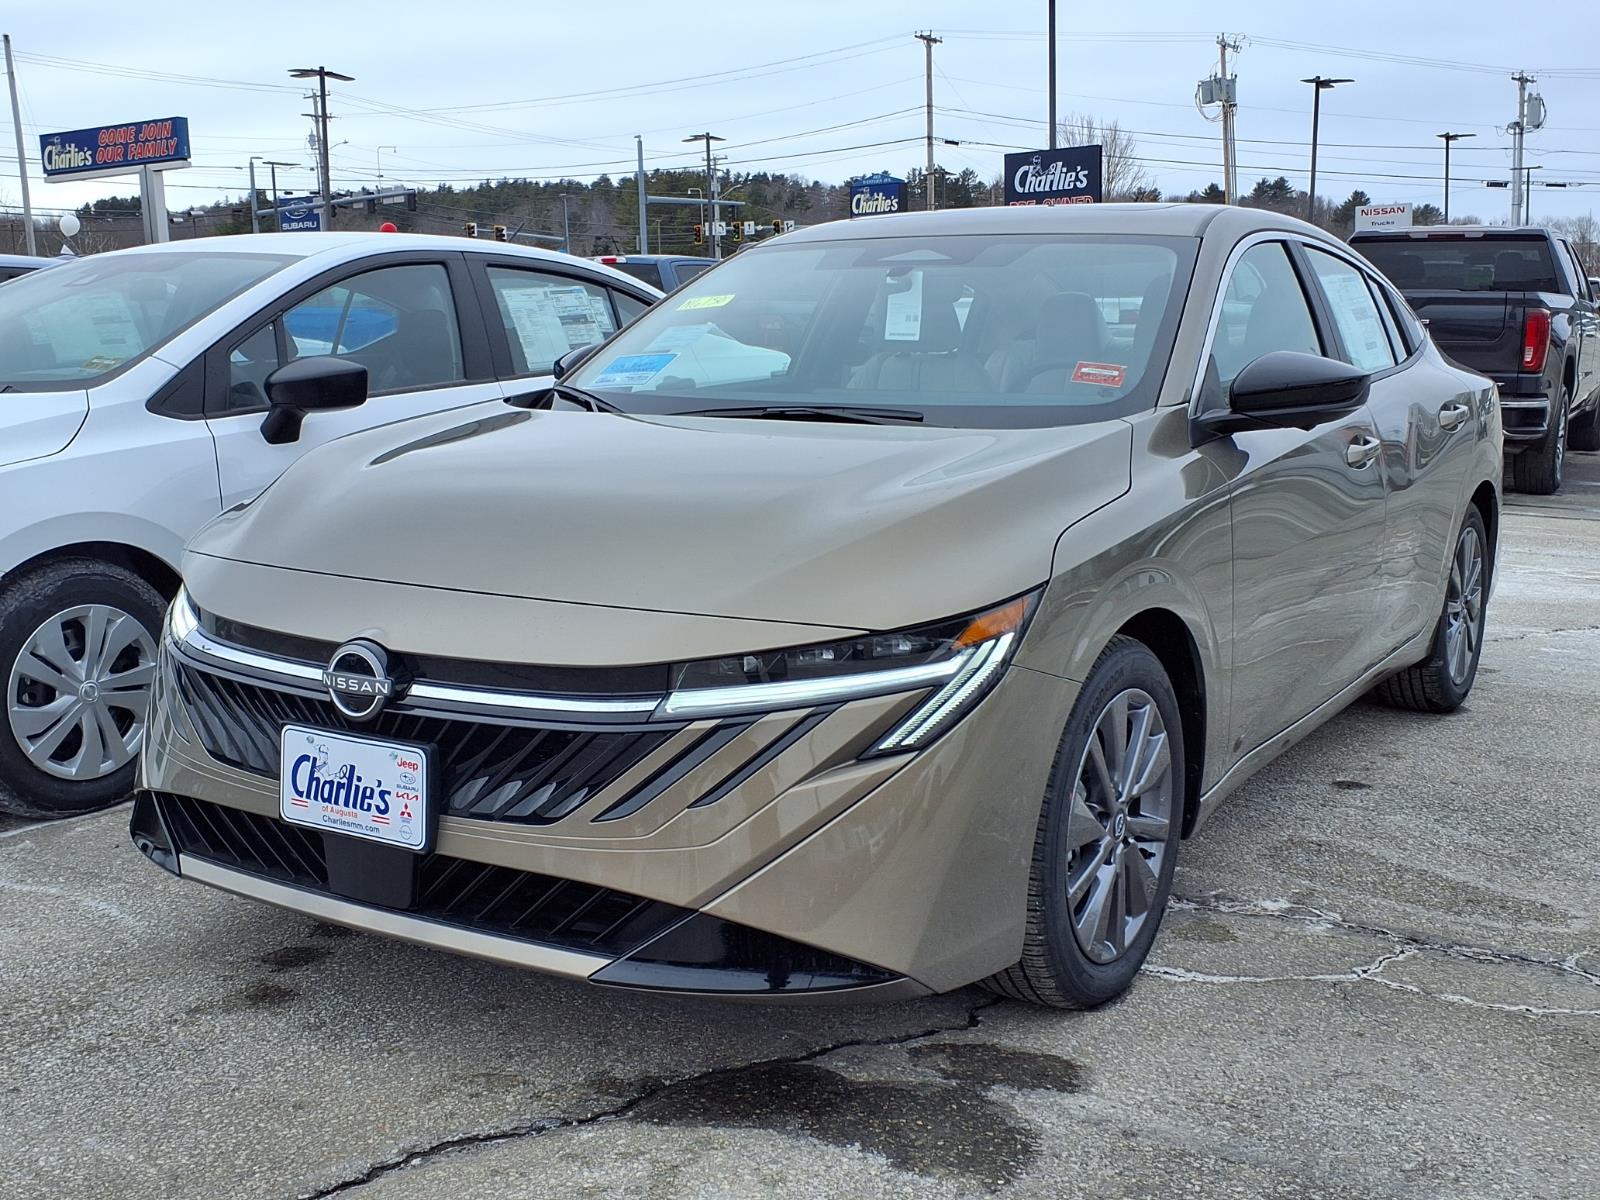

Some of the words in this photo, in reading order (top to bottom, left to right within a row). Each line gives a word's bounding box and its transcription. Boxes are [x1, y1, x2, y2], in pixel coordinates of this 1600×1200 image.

[98, 126, 136, 146] COME
[139, 121, 172, 141] JOIN
[43, 143, 92, 170] Charlie's
[96, 146, 124, 164] OUR
[127, 137, 177, 160] FAMILY
[1014, 161, 1089, 194] Charlie's
[852, 192, 899, 215] Charlie's
[1361, 206, 1405, 216] NISSAN
[282, 220, 317, 231] SUBARU
[323, 673, 388, 694] NISSAN
[397, 757, 419, 772] Jeep
[291, 753, 392, 816] Charlie's
[330, 805, 358, 819] Augusta
[322, 814, 380, 834] Charliesmm.com
